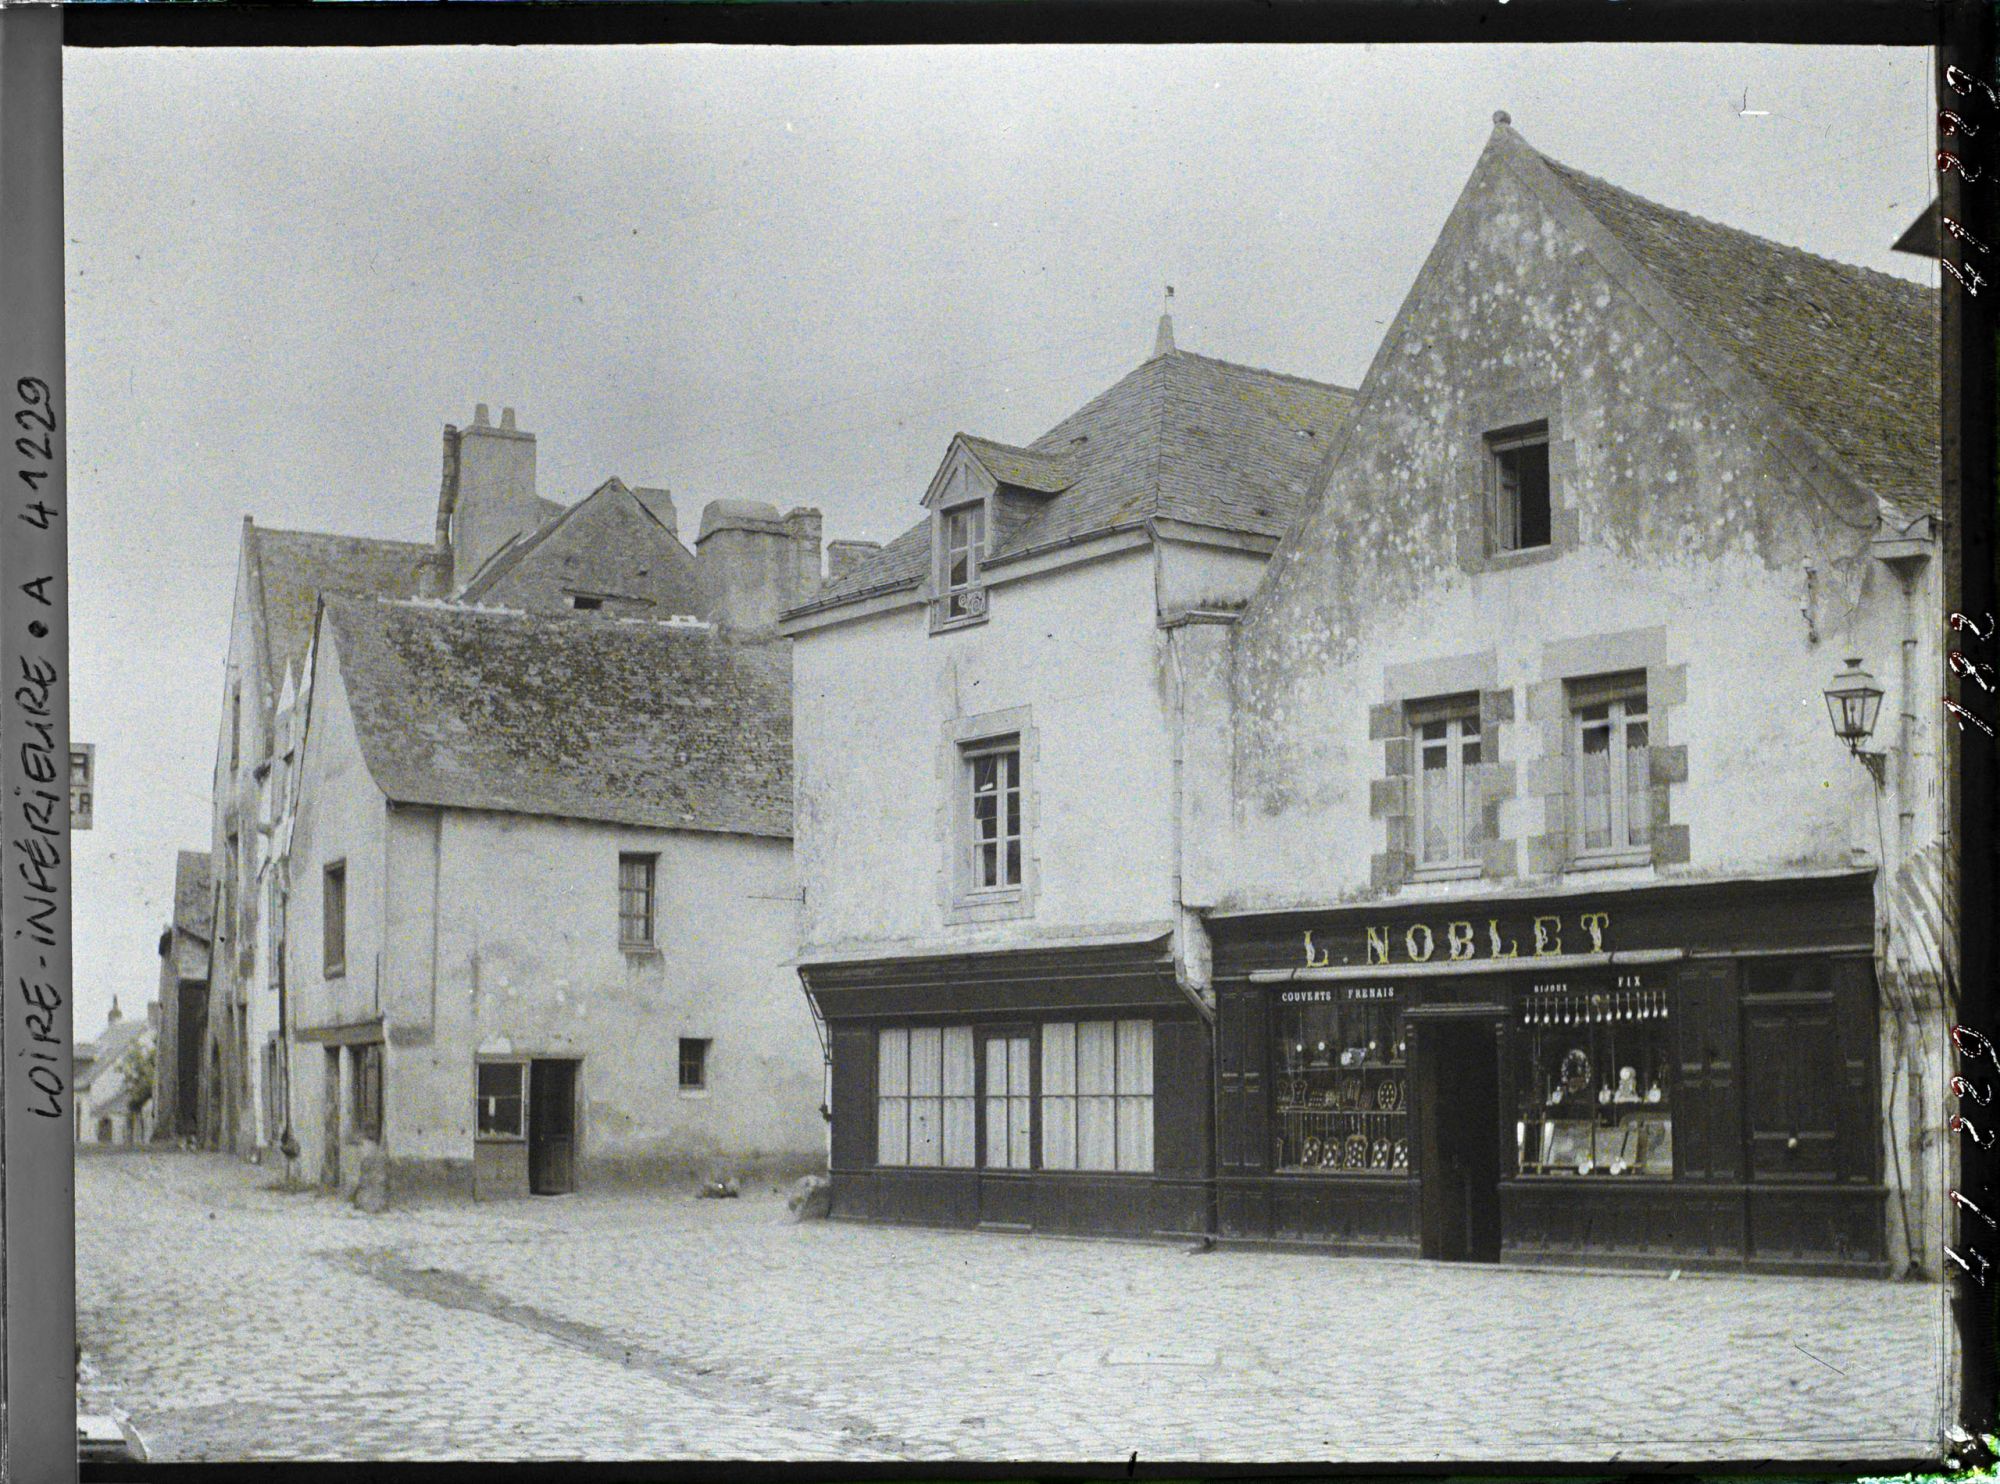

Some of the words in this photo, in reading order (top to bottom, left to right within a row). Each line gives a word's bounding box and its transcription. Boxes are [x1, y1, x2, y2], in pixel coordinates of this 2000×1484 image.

[15, 376, 58, 530] 41229
[1366, 912, 1609, 965] NOBLET
[1281, 991, 1332, 1002] COUVERTS
[1534, 984, 1567, 993] BIJOUX
[1618, 976, 1640, 988] FIX
